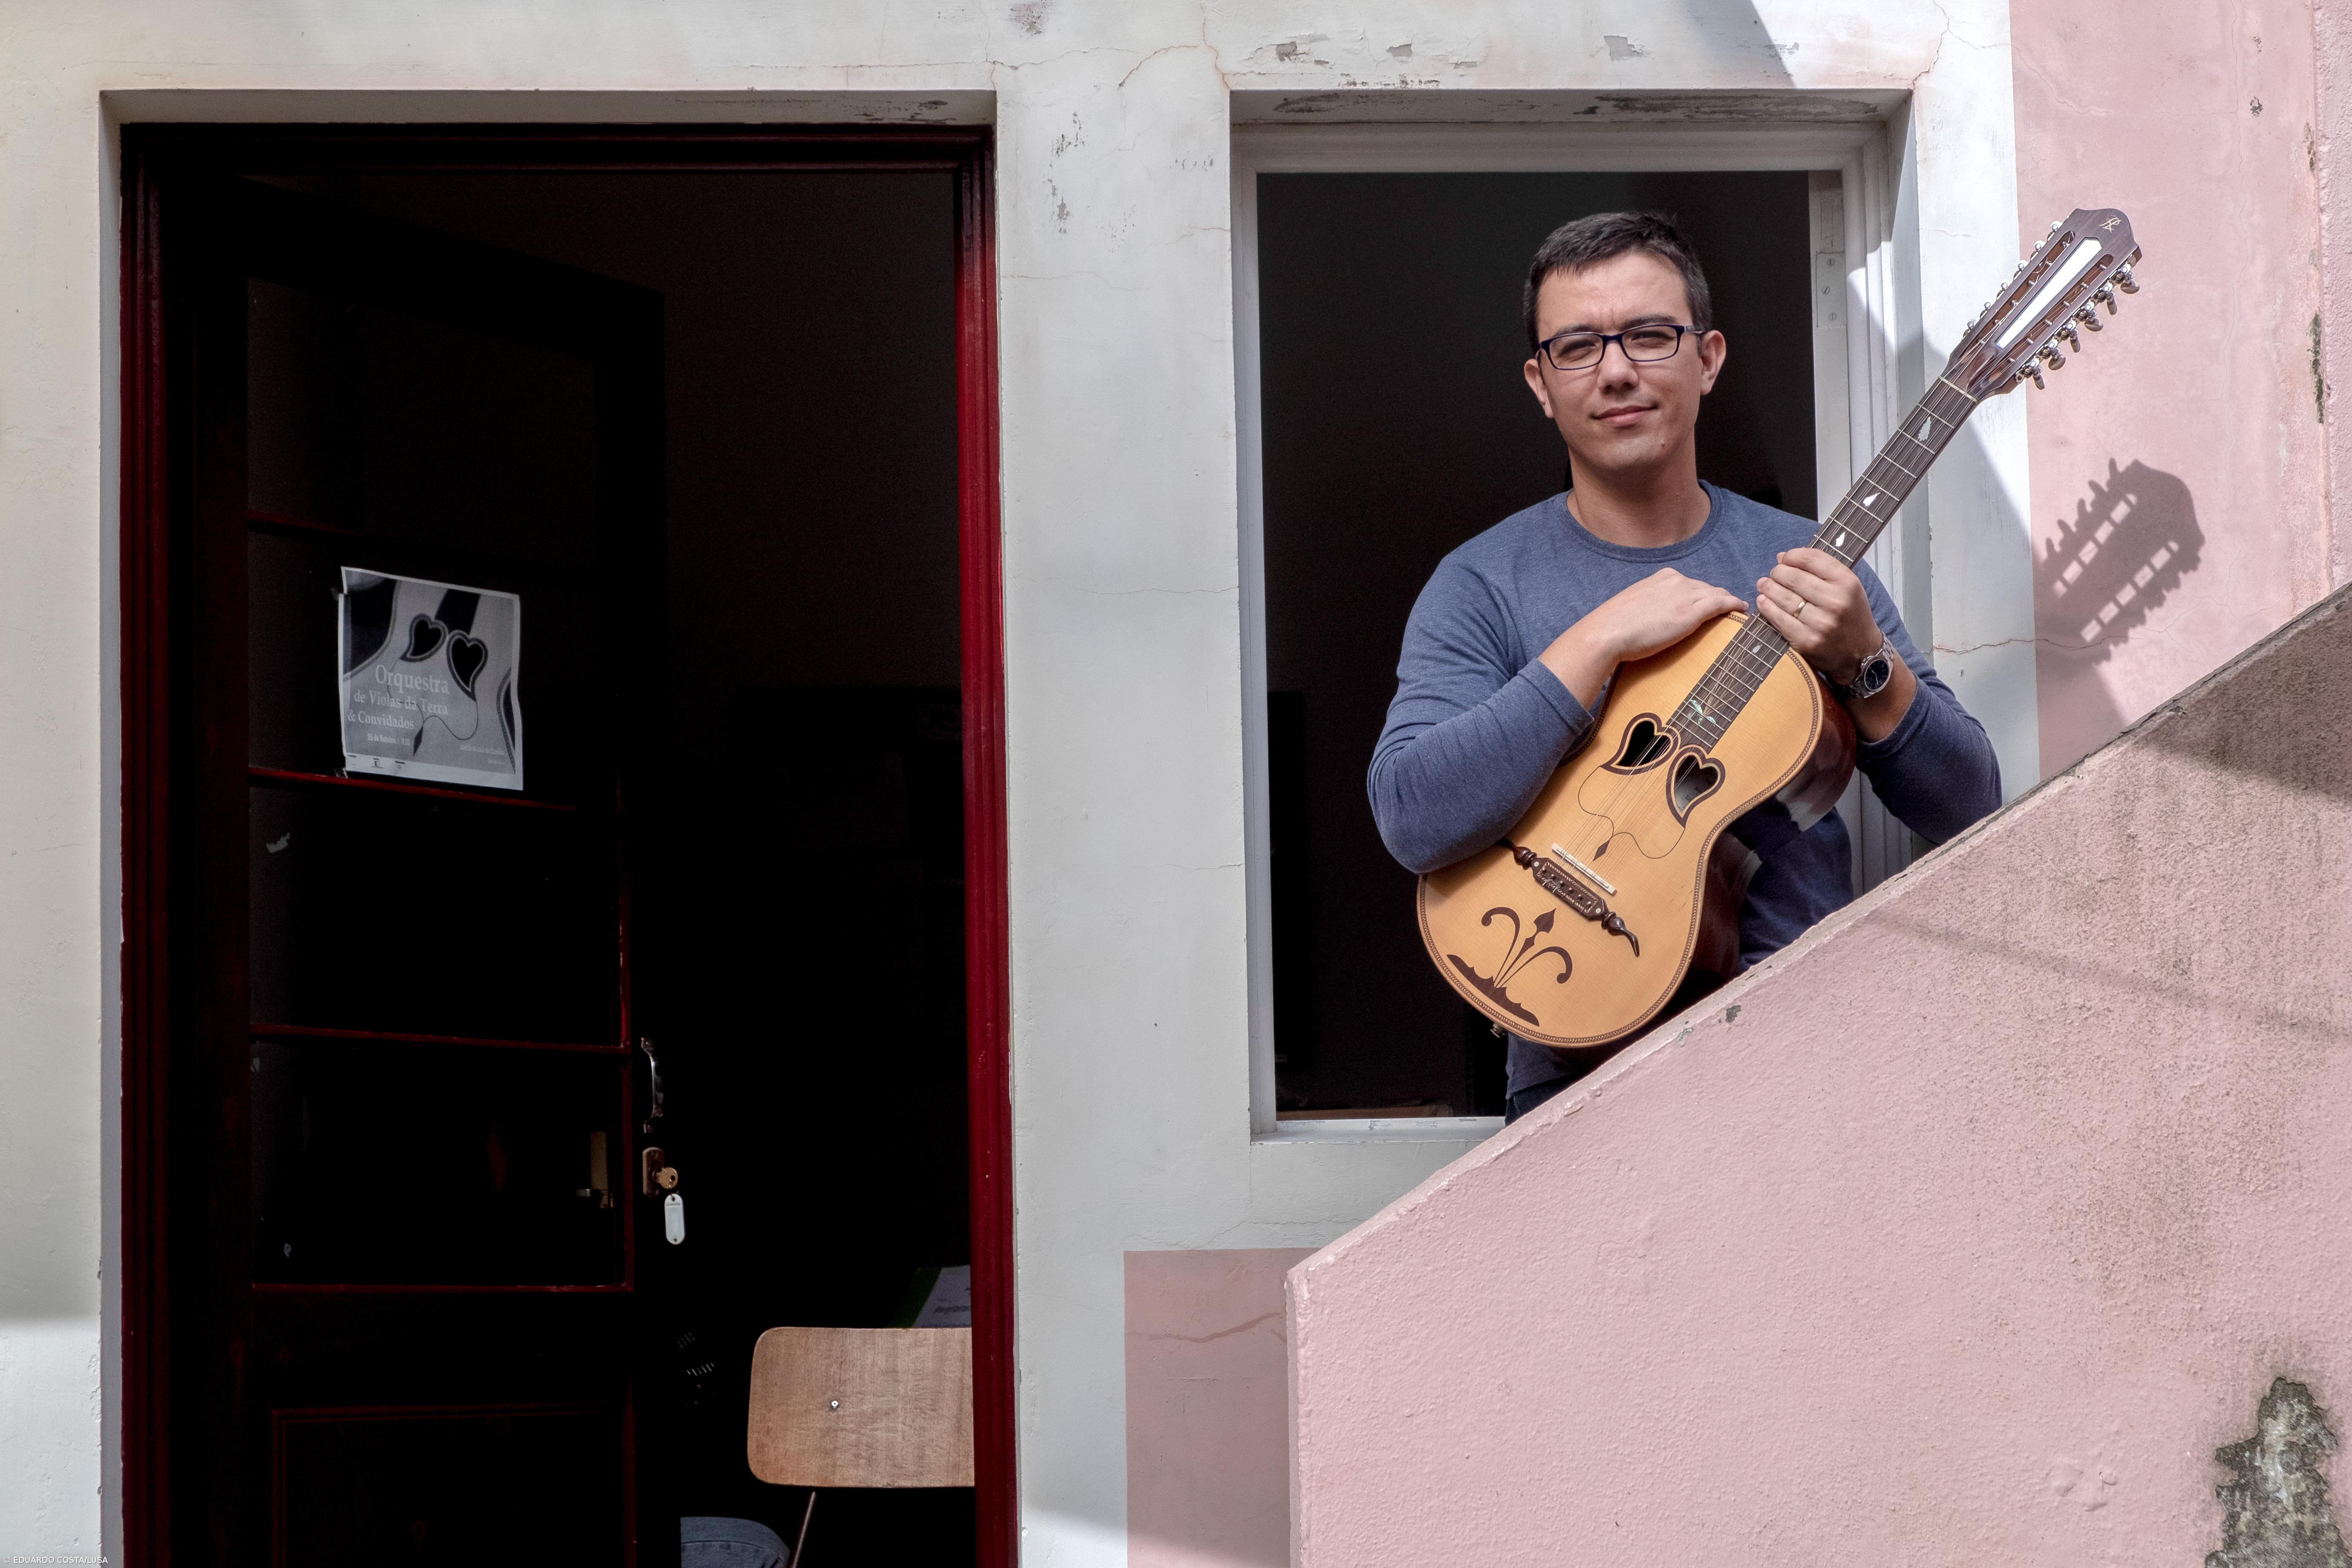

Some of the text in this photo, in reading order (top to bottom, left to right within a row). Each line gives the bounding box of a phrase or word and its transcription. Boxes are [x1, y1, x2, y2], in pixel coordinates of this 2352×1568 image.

[376, 665, 448, 693] Orquestra
[354, 690, 448, 714] de Violas da Terra
[348, 709, 414, 729] & Convidados
